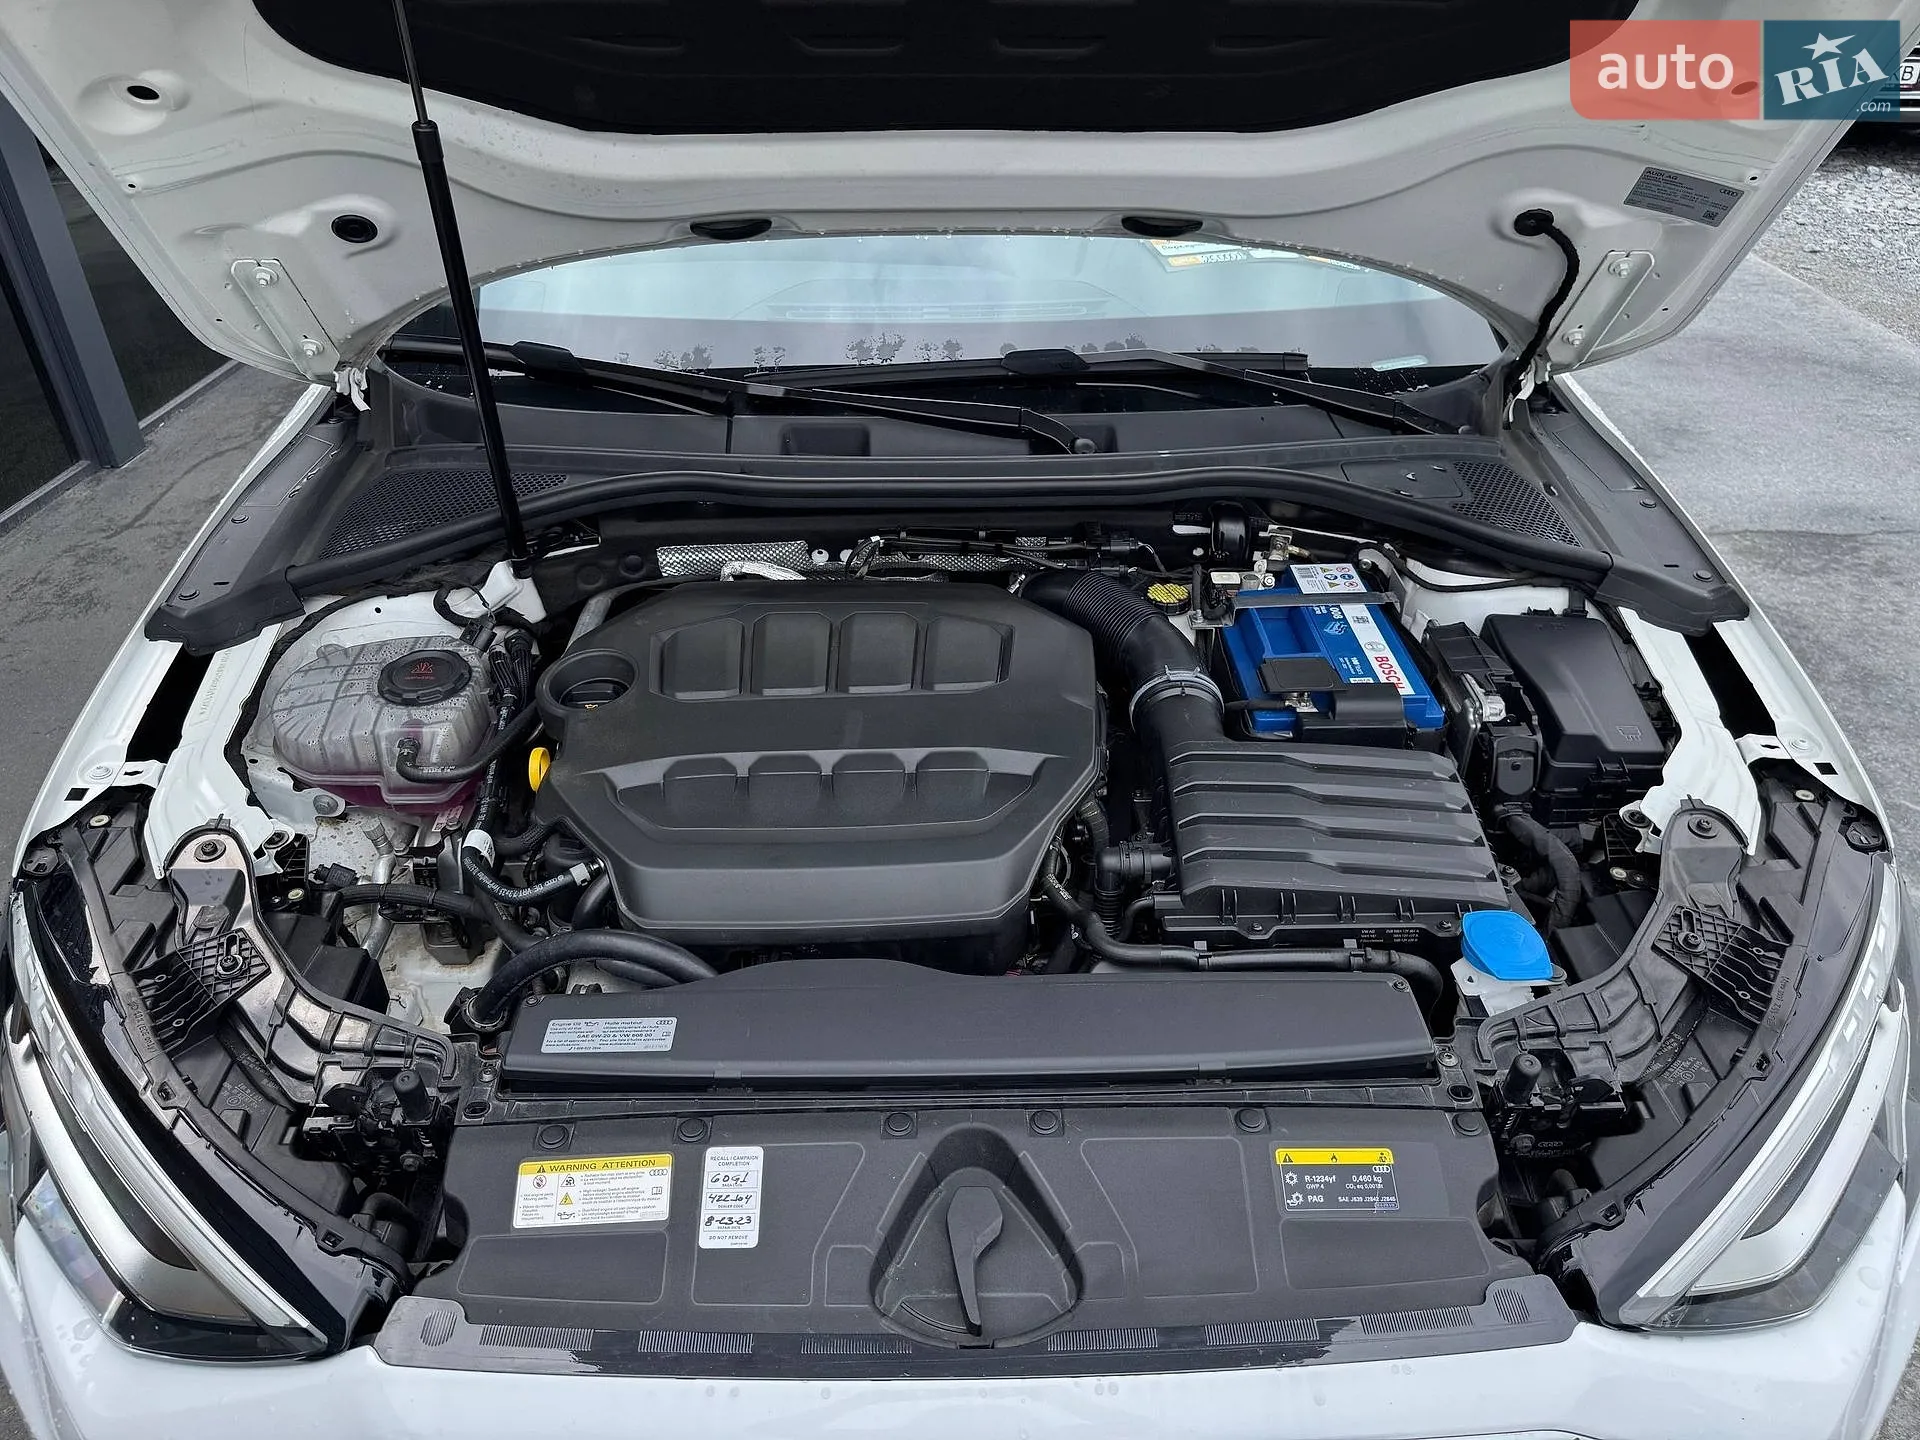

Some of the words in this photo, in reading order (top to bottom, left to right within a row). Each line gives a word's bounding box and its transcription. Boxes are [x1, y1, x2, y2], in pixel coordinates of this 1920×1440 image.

[1374, 656, 1406, 689] BOSCH
[549, 1162, 597, 1172] WARNING
[601, 1159, 656, 1169] ATTENTION
[1304, 1175, 1336, 1184] R-1234yf
[1373, 1174, 1382, 1184] kg
[1307, 1195, 1324, 1203] PAG
